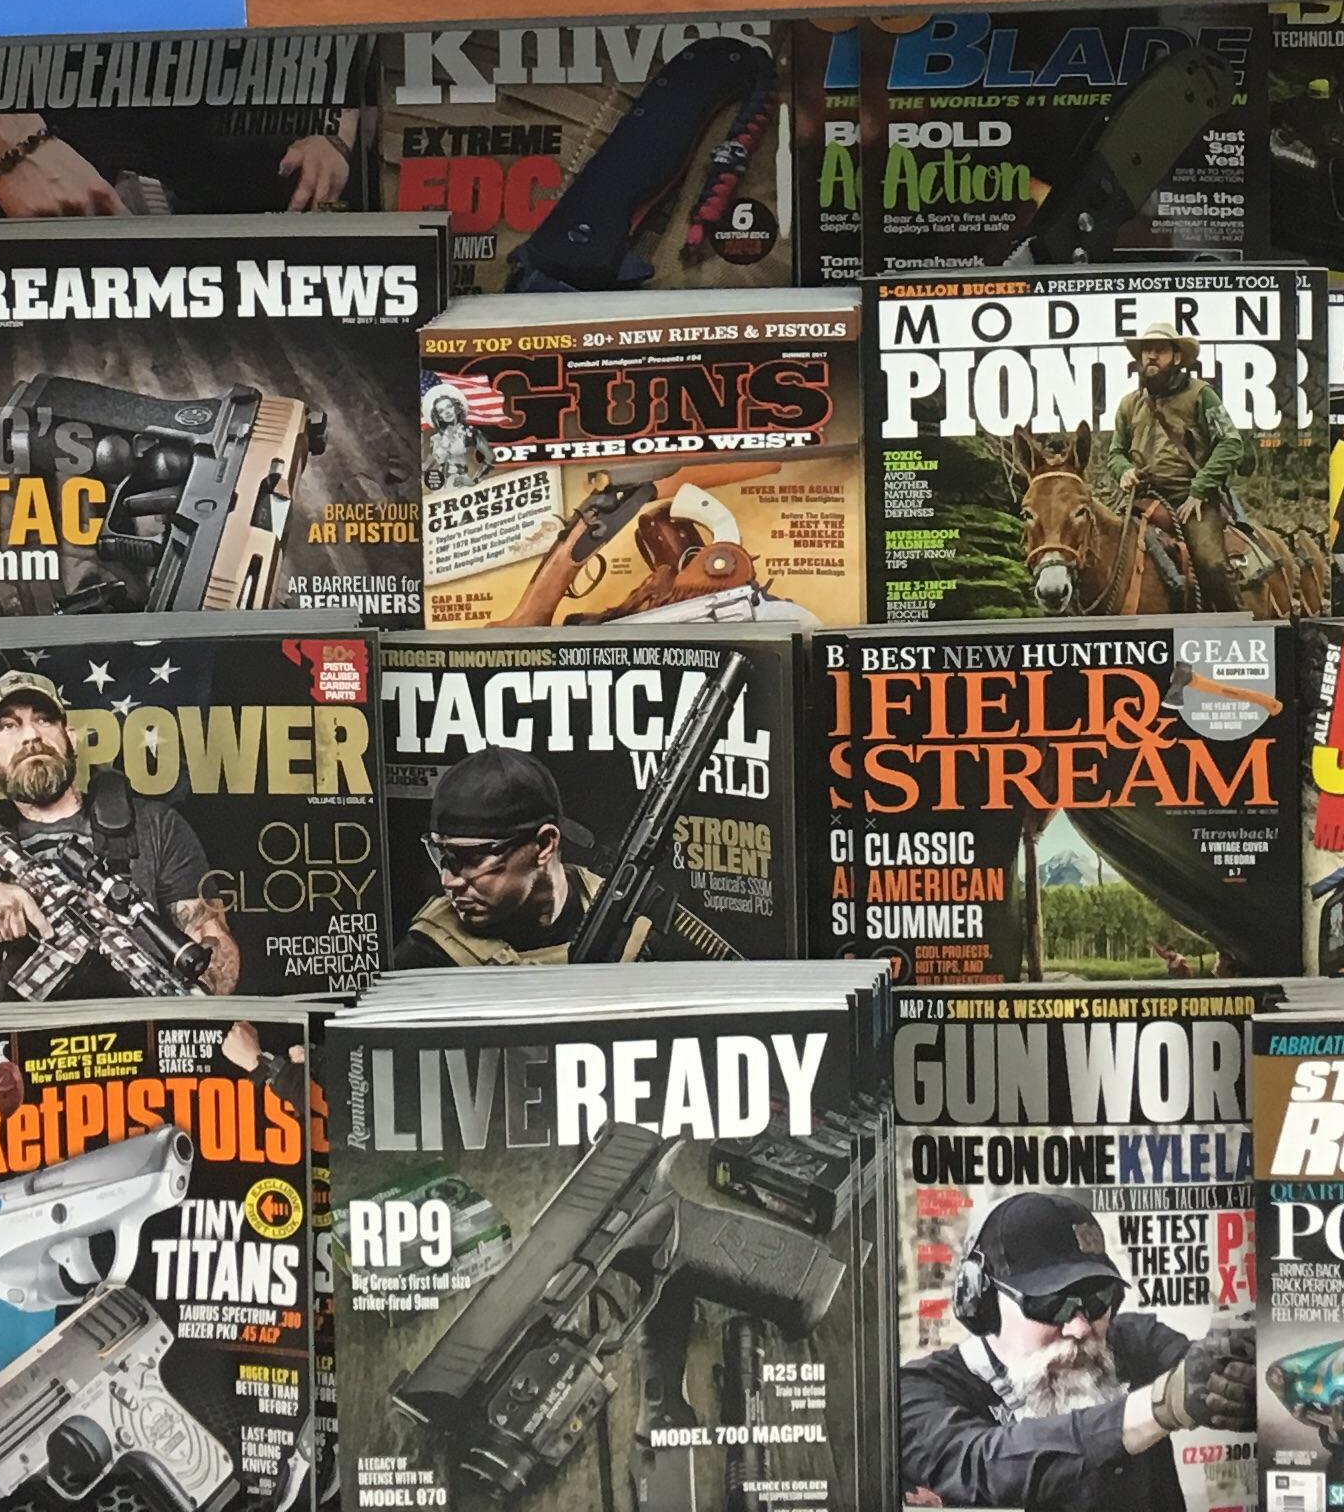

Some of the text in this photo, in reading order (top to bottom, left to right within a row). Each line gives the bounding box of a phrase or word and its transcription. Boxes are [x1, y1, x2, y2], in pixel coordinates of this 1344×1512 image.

[402, 125, 561, 154] EXTREME
[888, 122, 1011, 146] BOLD
[882, 144, 1031, 210] Action
[426, 322, 846, 354] 2017 TOP GUNS: 20+ NEW RIFLES & PISTOLS
[861, 640, 1268, 670] BEST NEW HUNTING GEAR
[862, 738, 1279, 812] STREAM
[258, 821, 371, 865] OLD
[864, 832, 974, 865] CLASSIC
[197, 869, 377, 912] GLORY
[866, 869, 1004, 902] AMERICAN
[327, 915, 377, 934] AERO
[866, 905, 983, 938] SUMMER
[350, 1199, 453, 1268] RP9
[152, 1241, 299, 1306] TITANS
[651, 1426, 826, 1446] MODEL 700 MAGPUL
